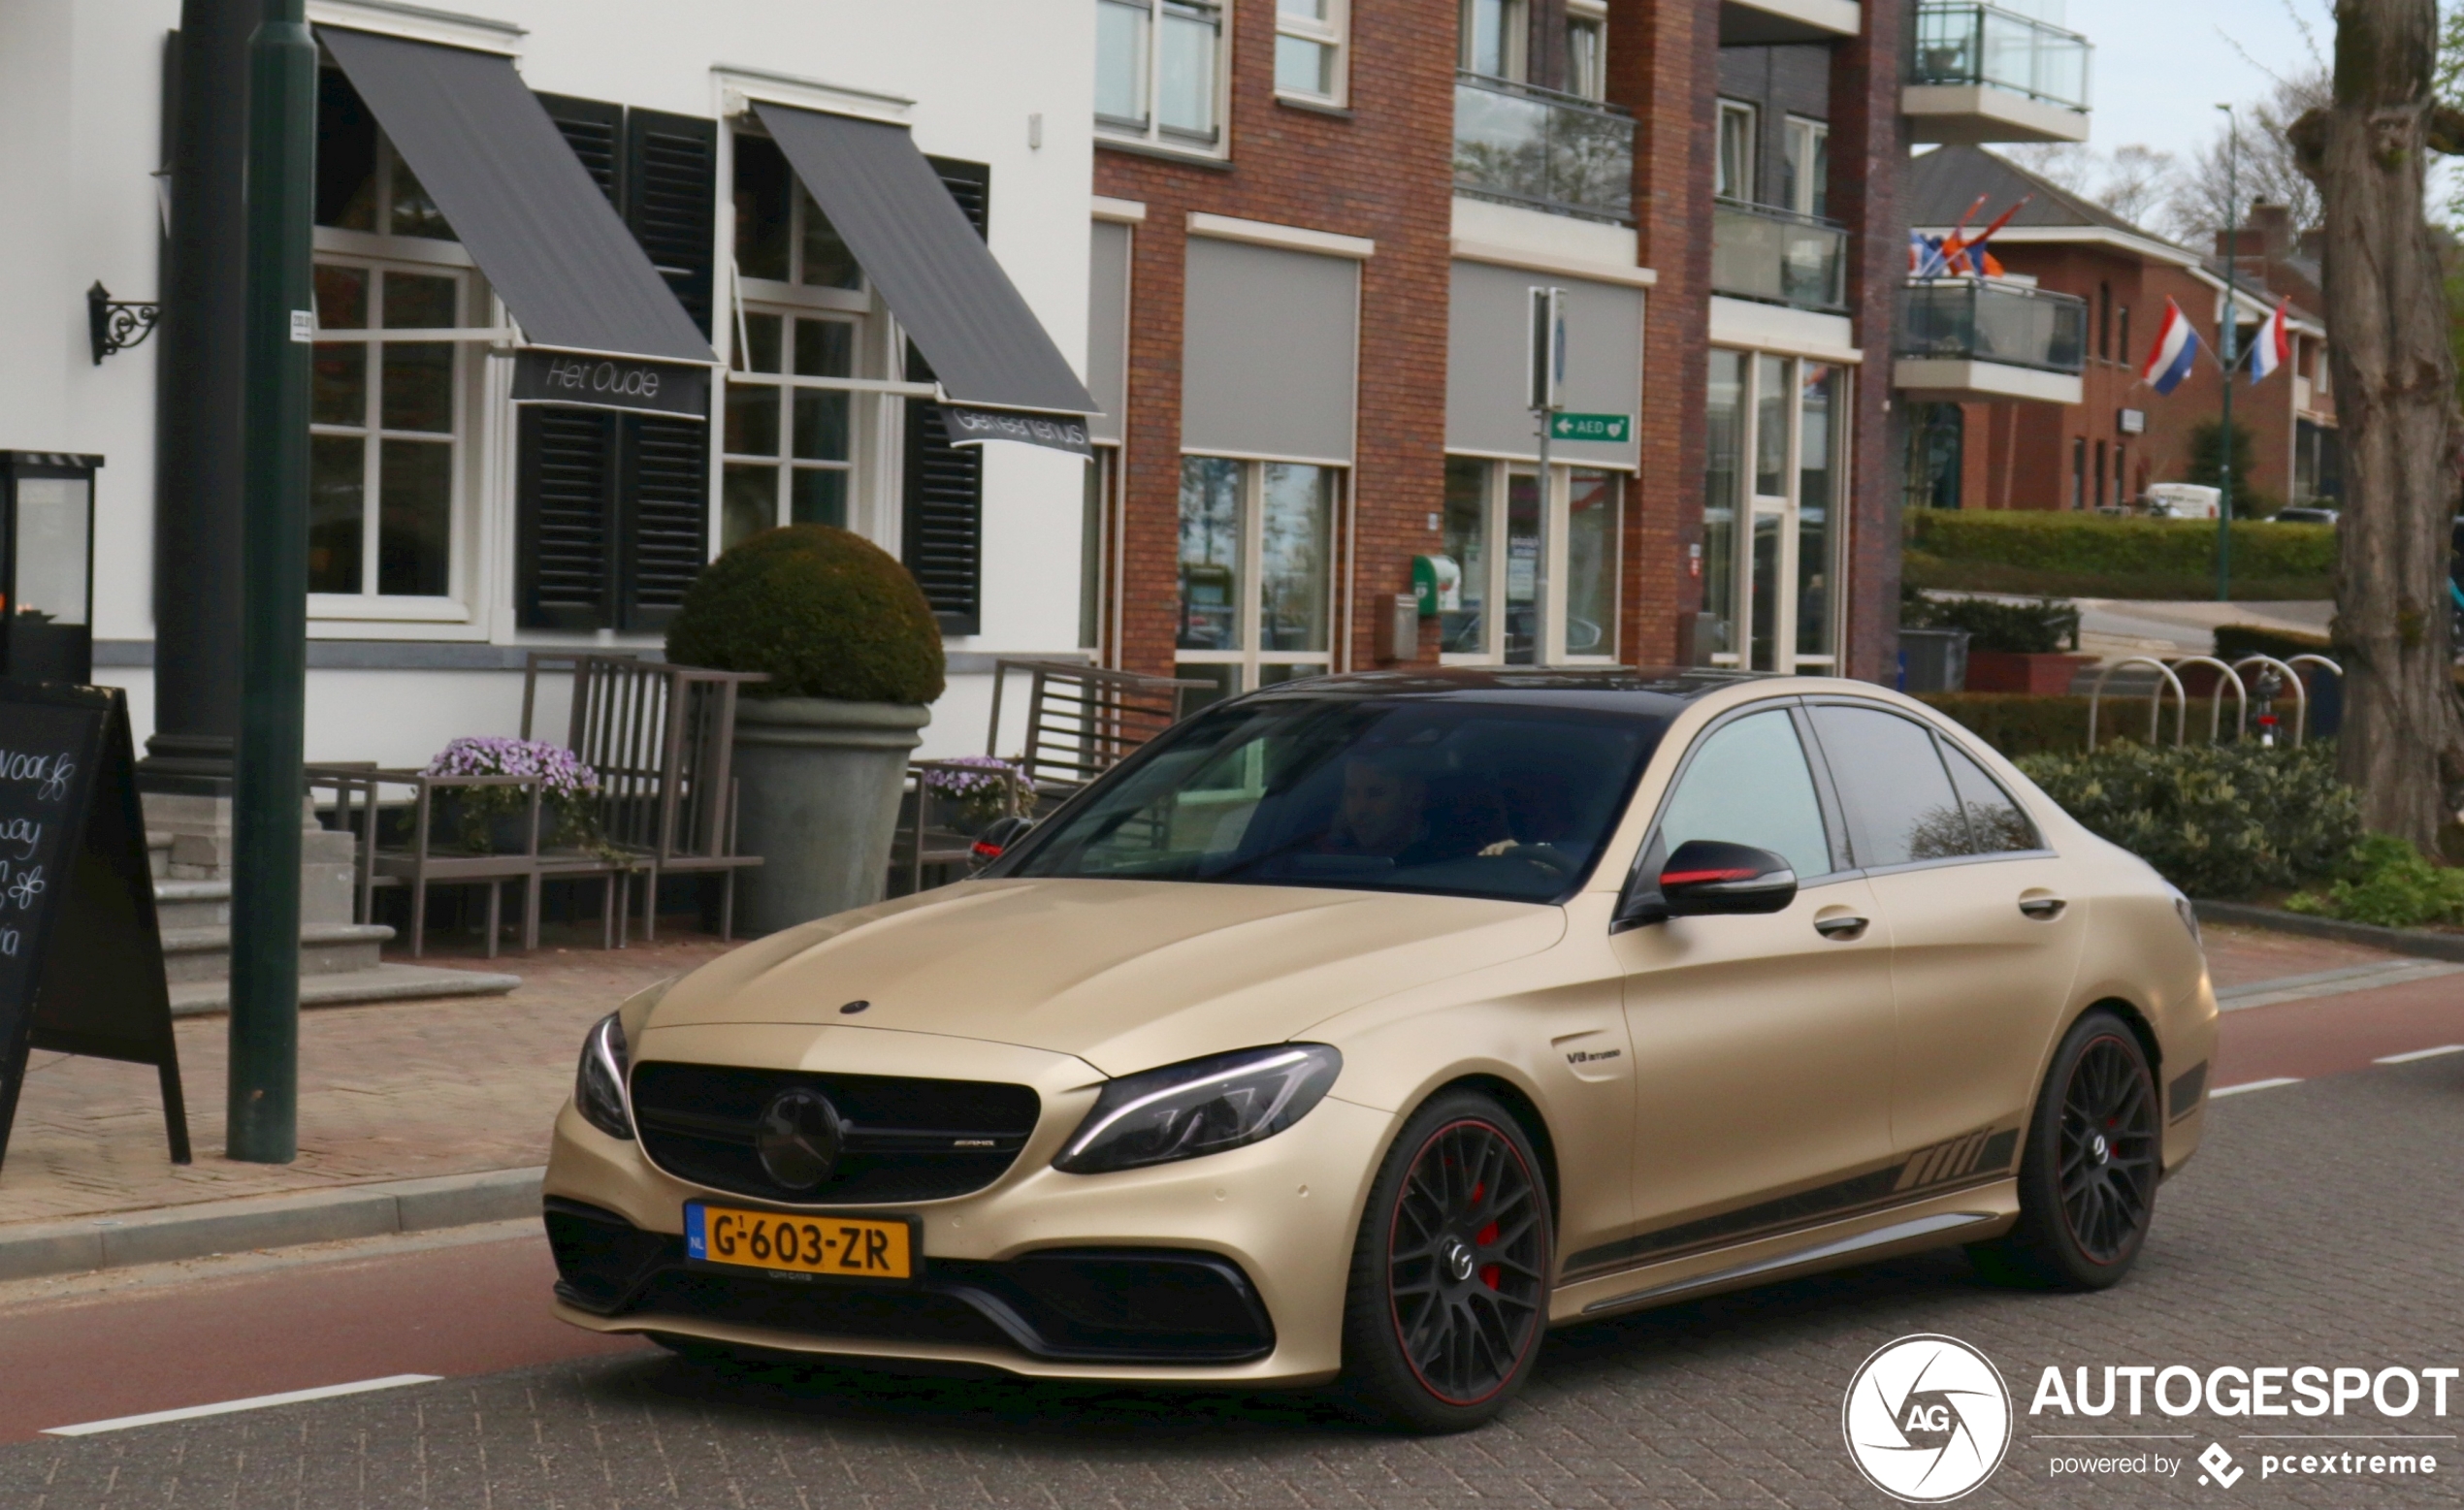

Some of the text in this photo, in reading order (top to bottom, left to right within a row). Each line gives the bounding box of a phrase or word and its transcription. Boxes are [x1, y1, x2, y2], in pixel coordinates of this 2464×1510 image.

[546, 358, 660, 398] Het Oude
[1576, 420, 1605, 434] AED
[1566, 1051, 1587, 1064] V8
[690, 1236, 704, 1251] NL
[713, 1214, 891, 1271] G-603-ZR
